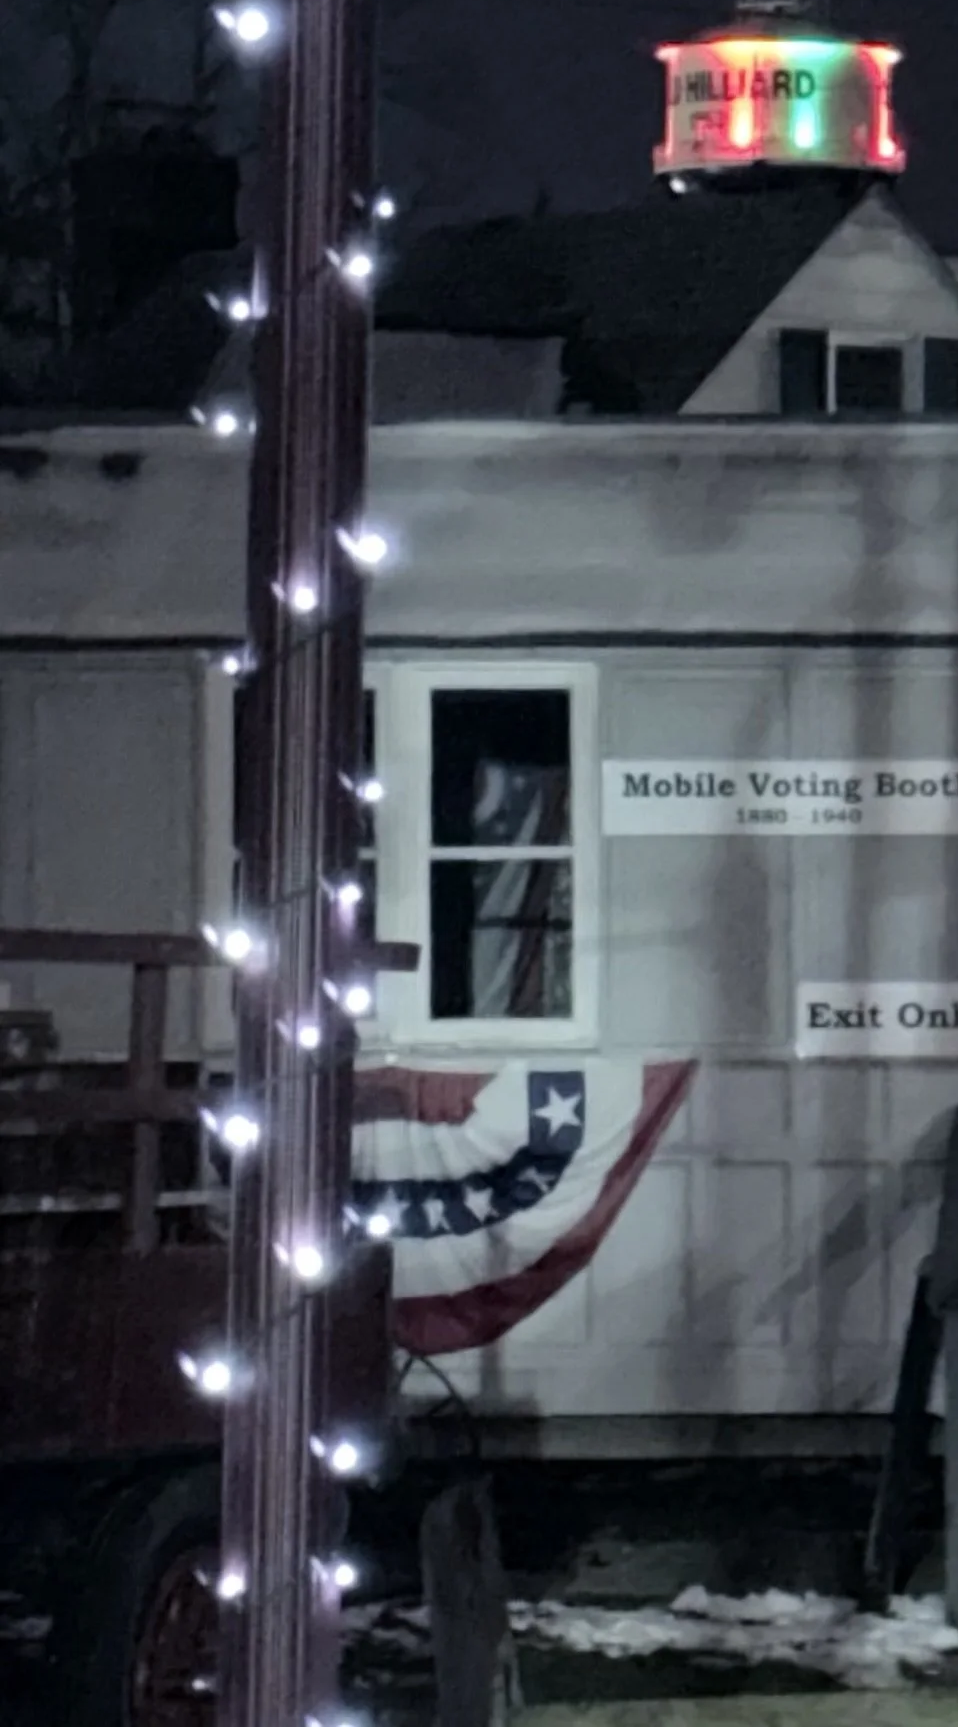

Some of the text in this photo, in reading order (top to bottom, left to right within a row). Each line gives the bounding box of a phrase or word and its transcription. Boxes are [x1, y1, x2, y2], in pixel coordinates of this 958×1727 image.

[622, 773, 736, 798] Mobile
[748, 773, 863, 804] Voting
[807, 1002, 882, 1029] Exit
